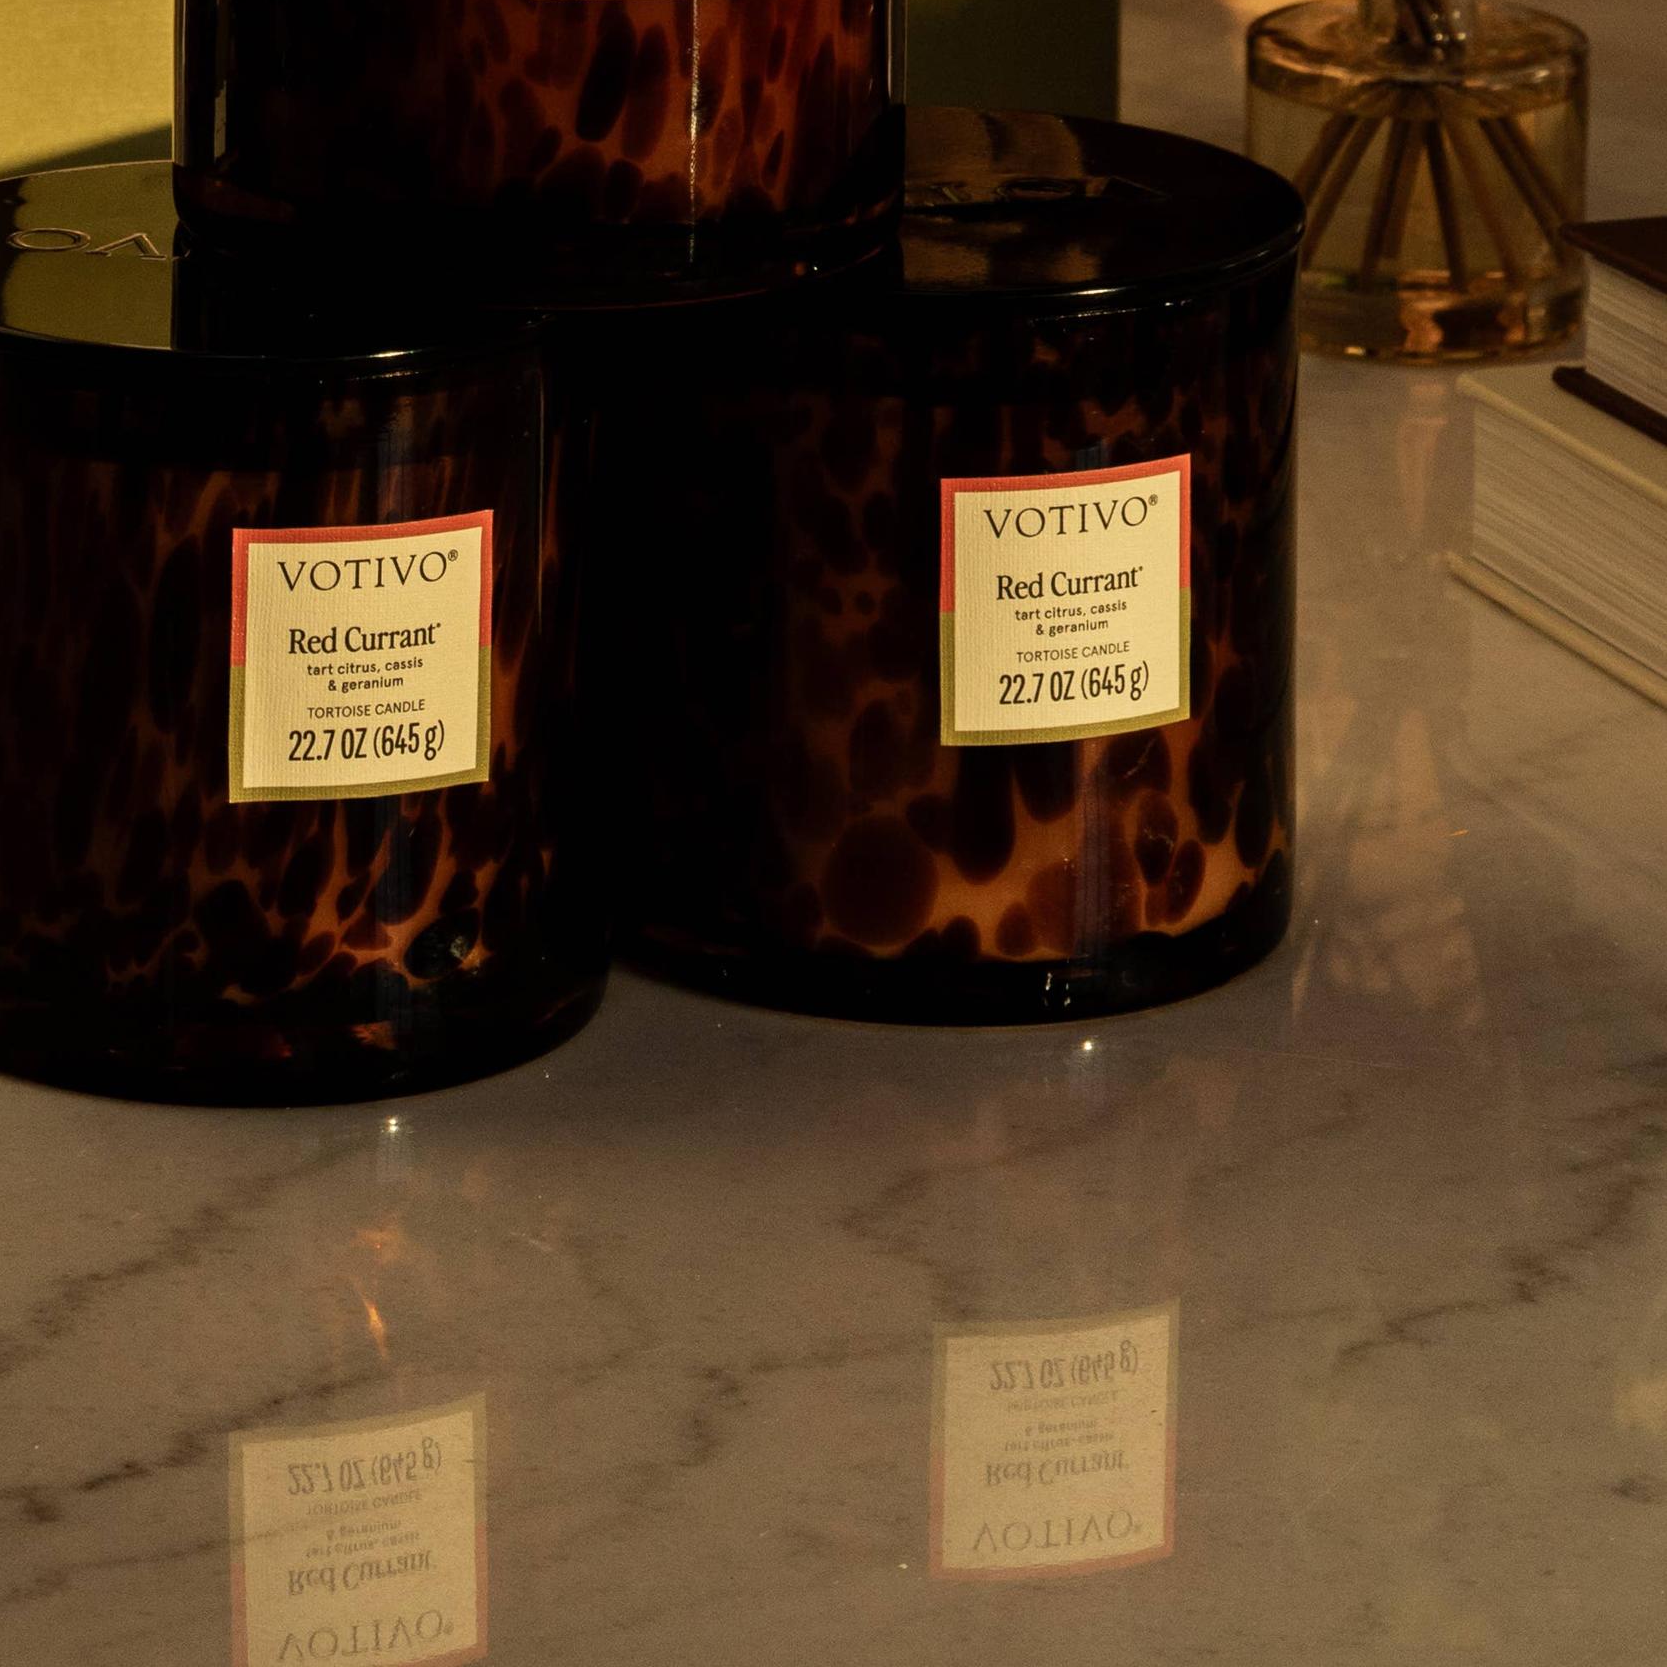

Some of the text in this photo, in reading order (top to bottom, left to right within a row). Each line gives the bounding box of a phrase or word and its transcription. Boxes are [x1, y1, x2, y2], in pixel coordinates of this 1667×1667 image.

[996, 568, 1139, 601] Red Currant
[1014, 599, 1128, 622] tart citrus, cassis
[288, 624, 436, 655] Red Currant
[1035, 619, 1109, 638] & geranium
[1016, 640, 1130, 664] TORTOISE CANDLE
[307, 657, 424, 677] tart citrus, cassis
[327, 676, 404, 694] & geranium
[999, 660, 1149, 706] 22.7 OZ (645 g)
[307, 699, 426, 719] TORTOISE CANDLE
[288, 719, 445, 762] 22.7 OZ (645 g)
